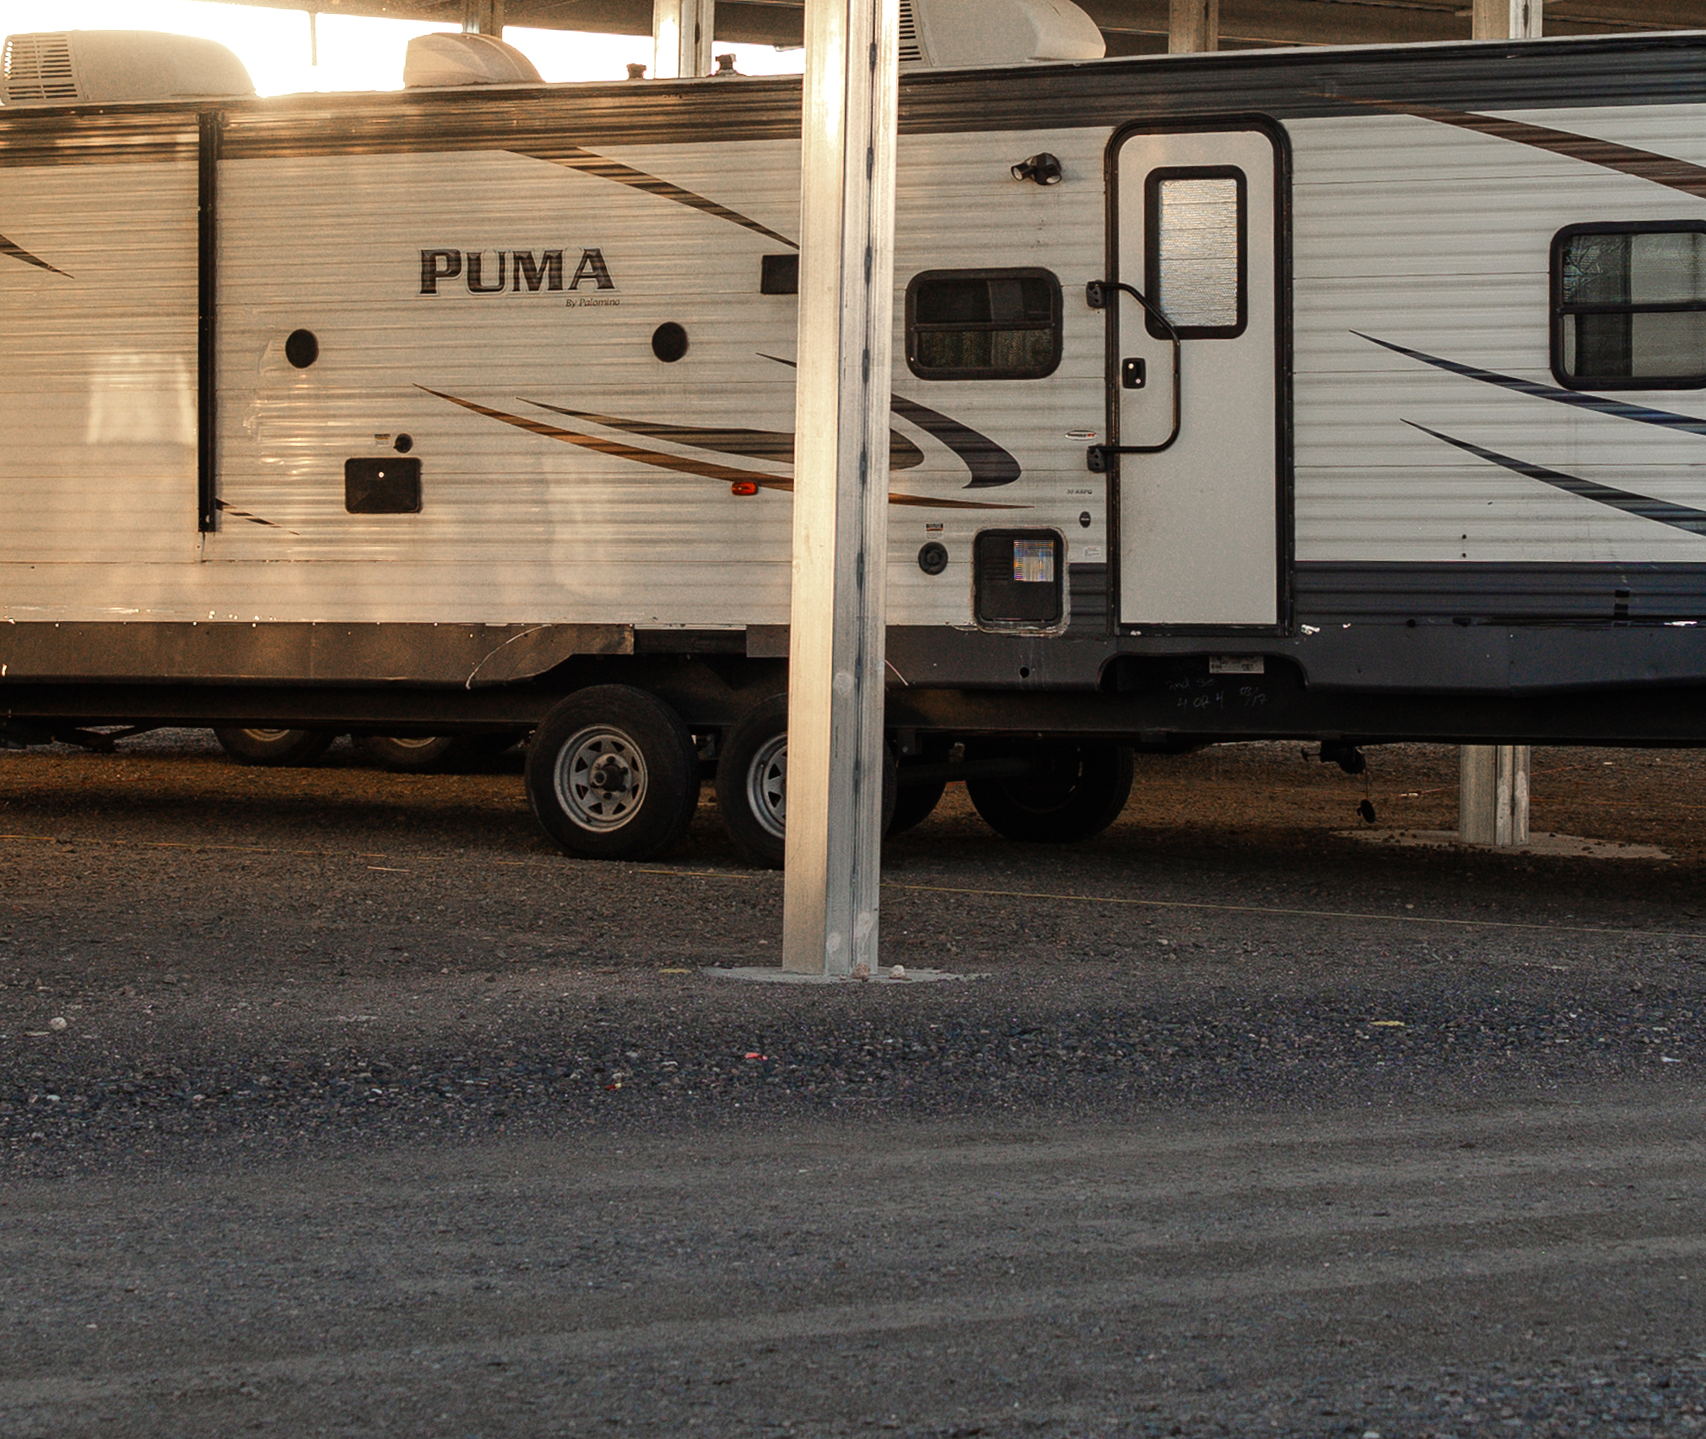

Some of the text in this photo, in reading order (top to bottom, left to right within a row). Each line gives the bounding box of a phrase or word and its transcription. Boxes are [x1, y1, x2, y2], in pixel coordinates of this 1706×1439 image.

[417, 247, 619, 296] PUMA
[565, 297, 621, 308] By Palomino
